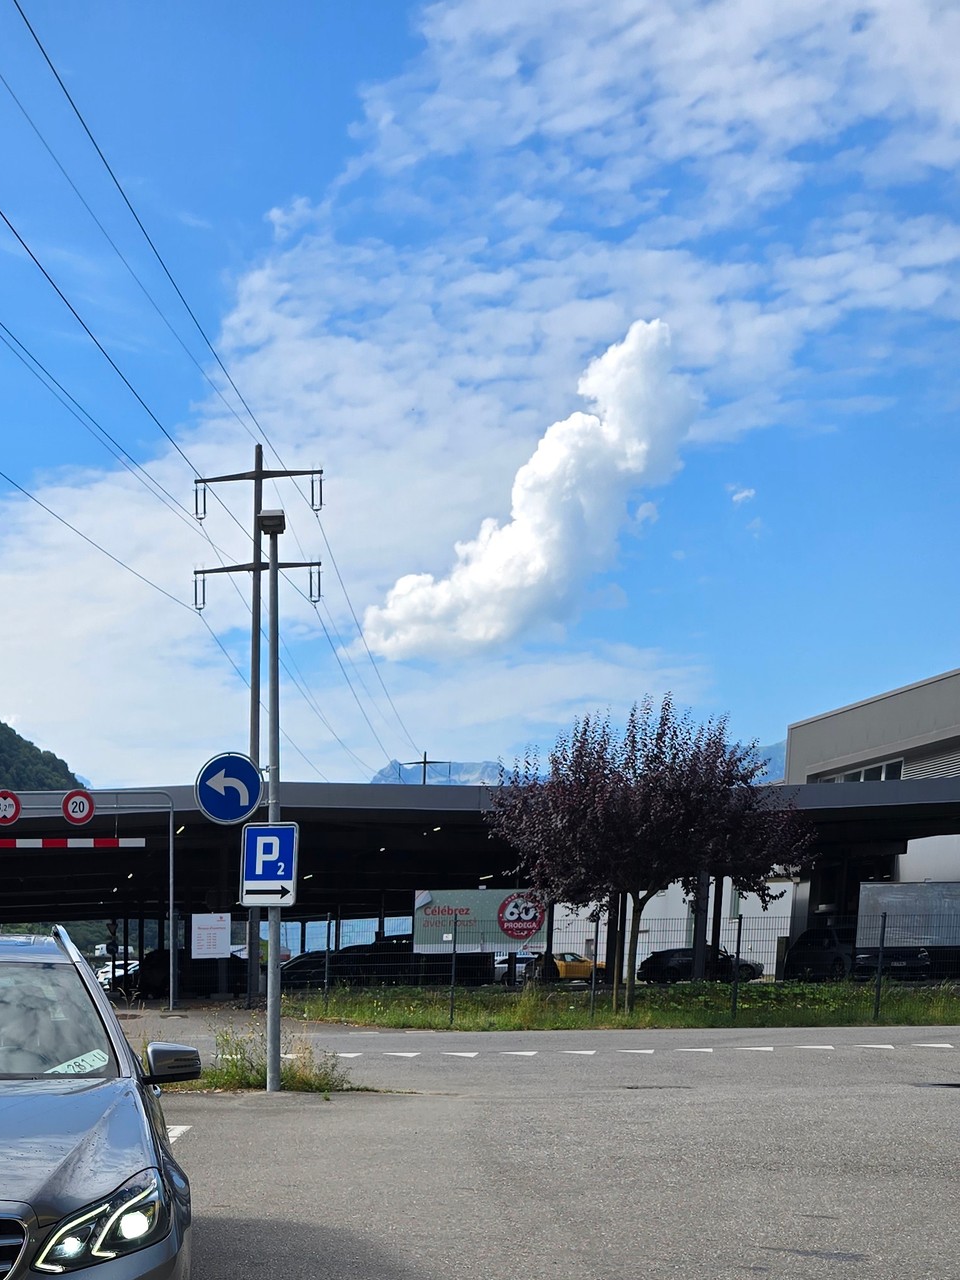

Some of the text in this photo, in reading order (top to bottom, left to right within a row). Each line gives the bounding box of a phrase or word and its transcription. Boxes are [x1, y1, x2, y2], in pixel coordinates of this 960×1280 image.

[71, 801, 85, 814] 20
[423, 905, 470, 916] Célébrez
[422, 919, 445, 928] avec
